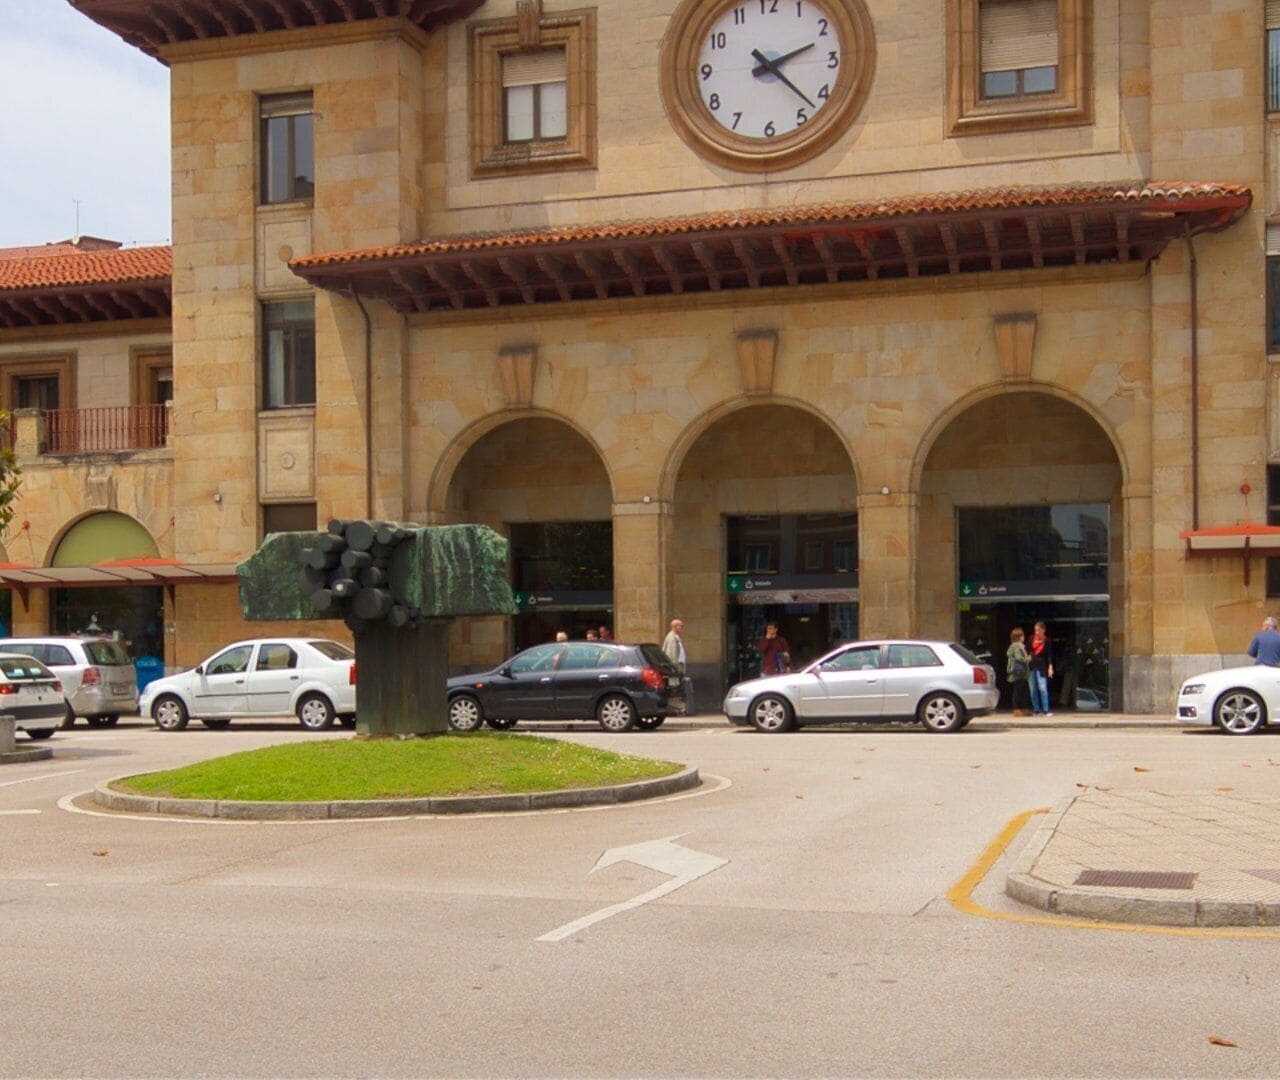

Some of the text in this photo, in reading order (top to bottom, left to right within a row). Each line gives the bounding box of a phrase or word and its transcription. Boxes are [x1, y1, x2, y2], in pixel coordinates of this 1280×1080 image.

[734, 7, 745, 25] 11
[796, 1, 802, 18] 1
[817, 18, 828, 36] 2
[711, 32, 726, 50] 10
[827, 51, 839, 69] 3
[701, 64, 713, 81] 9
[817, 83, 829, 101] 4
[709, 93, 721, 110] 8
[732, 112, 743, 130] 7
[796, 108, 808, 127] 5
[764, 121, 776, 137] 6
